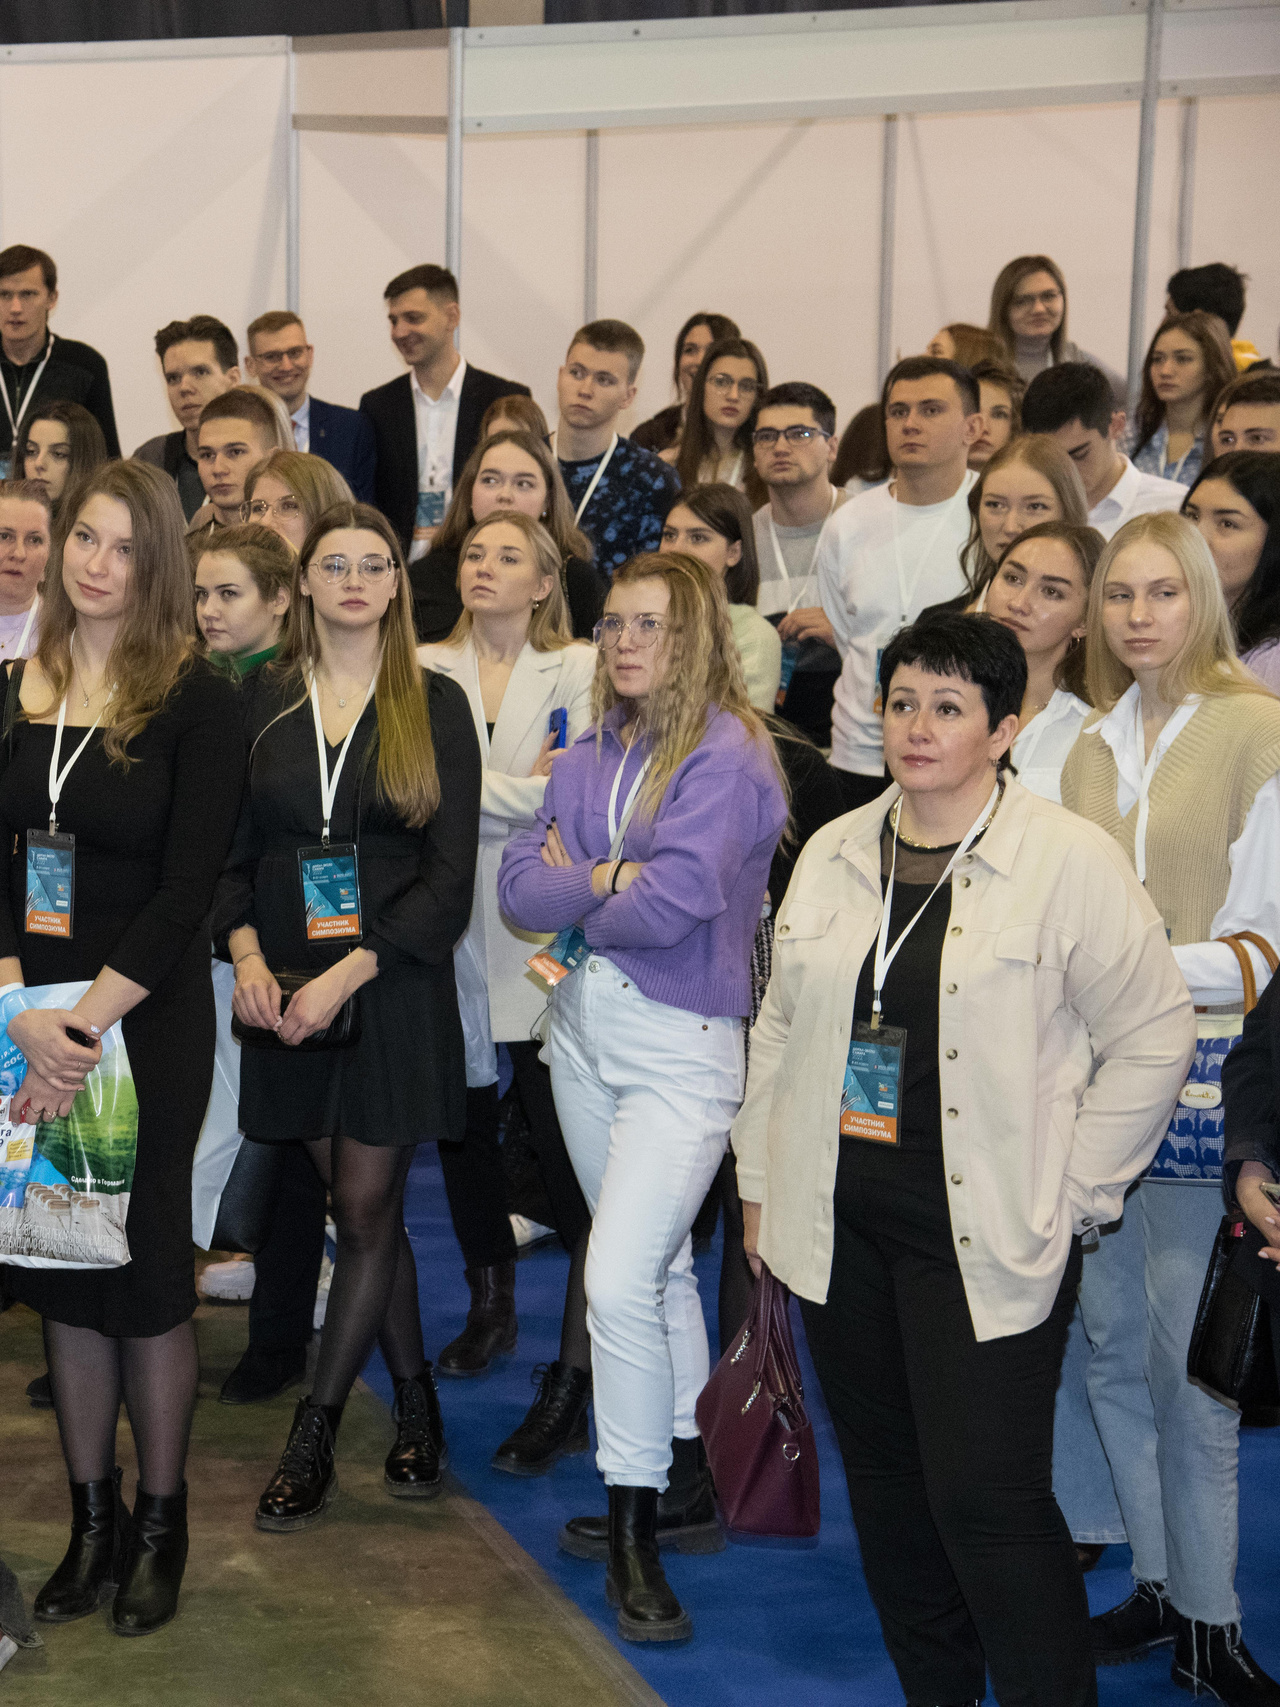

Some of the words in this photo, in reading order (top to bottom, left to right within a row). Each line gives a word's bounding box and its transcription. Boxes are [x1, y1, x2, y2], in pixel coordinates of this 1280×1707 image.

[34, 915, 62, 924] УЧАСТНИК
[316, 920, 350, 928] УЧАСТНИК
[29, 923, 66, 933] СИМПОЗИУМА
[311, 927, 356, 936] СИМПОЗИУМА
[850, 1116, 885, 1128] УЧАСТНИК
[843, 1124, 892, 1139] СИМПОЗИУМА
